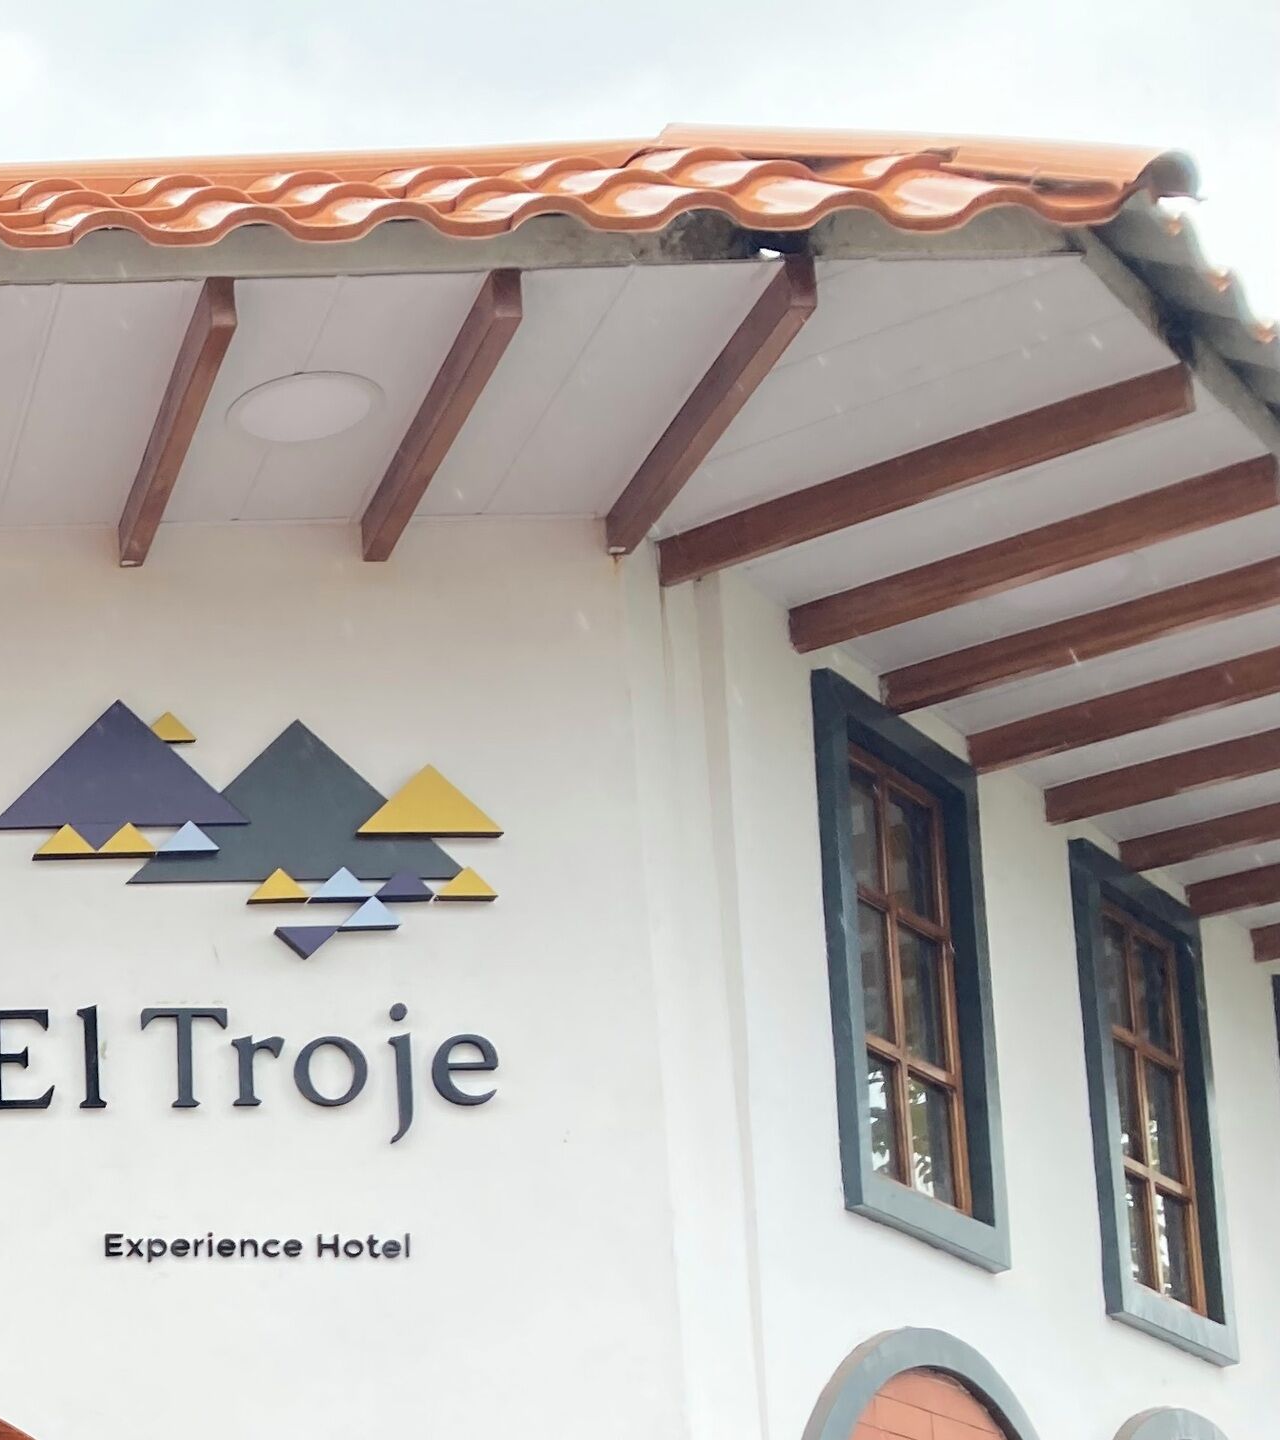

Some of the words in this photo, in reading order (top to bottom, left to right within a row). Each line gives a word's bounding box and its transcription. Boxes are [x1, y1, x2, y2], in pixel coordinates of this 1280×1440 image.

[140, 1002, 499, 1145] Troje
[104, 1232, 303, 1263] Experience
[316, 1232, 411, 1259] Hotel
